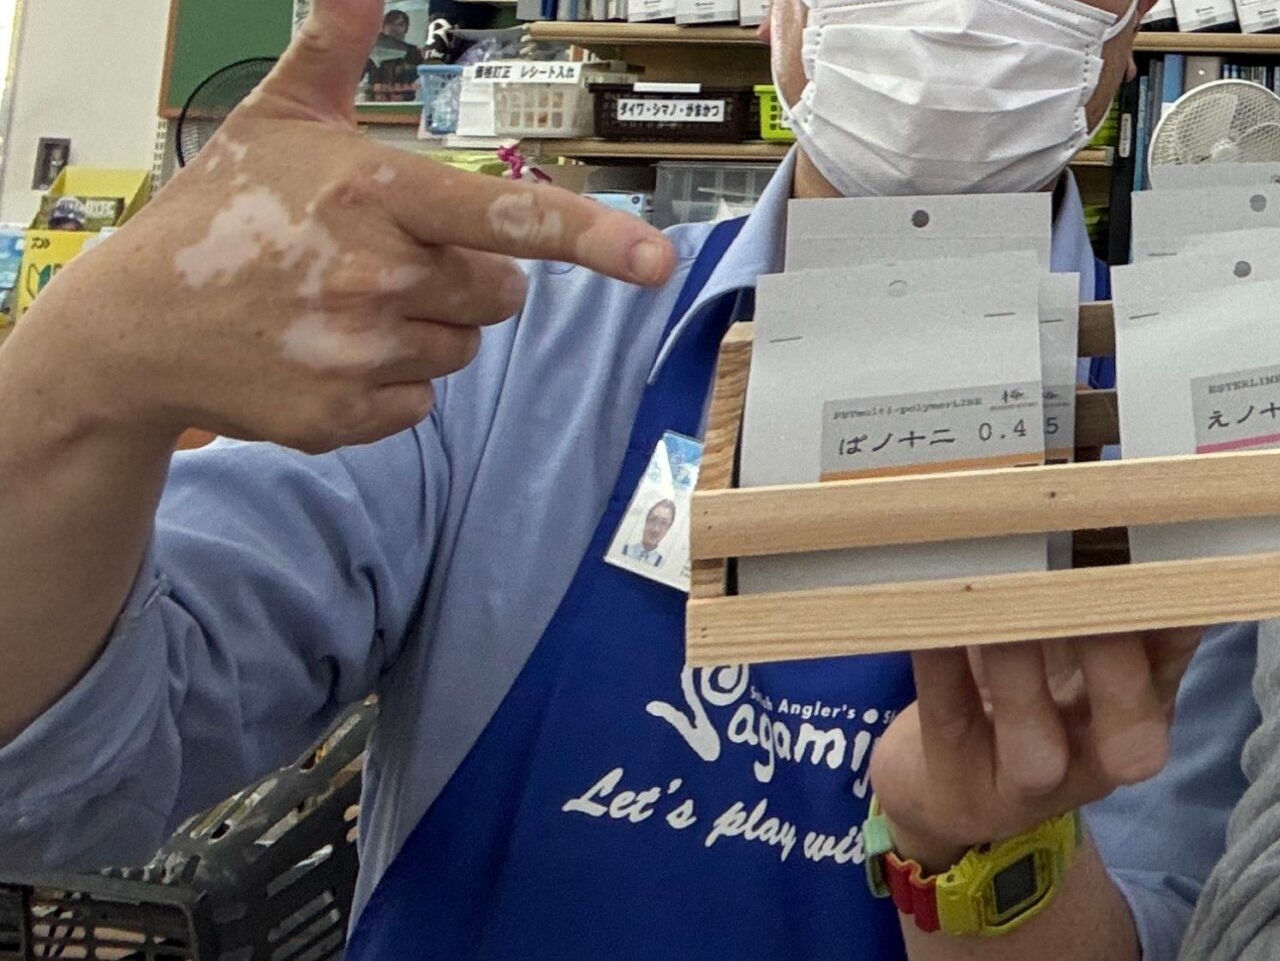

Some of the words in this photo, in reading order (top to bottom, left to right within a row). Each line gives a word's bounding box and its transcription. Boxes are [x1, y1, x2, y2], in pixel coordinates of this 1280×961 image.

[777, 698, 857, 720] Angler's
[561, 767, 698, 830] Let's
[704, 797, 797, 862] play
[803, 825, 866, 865] wit
